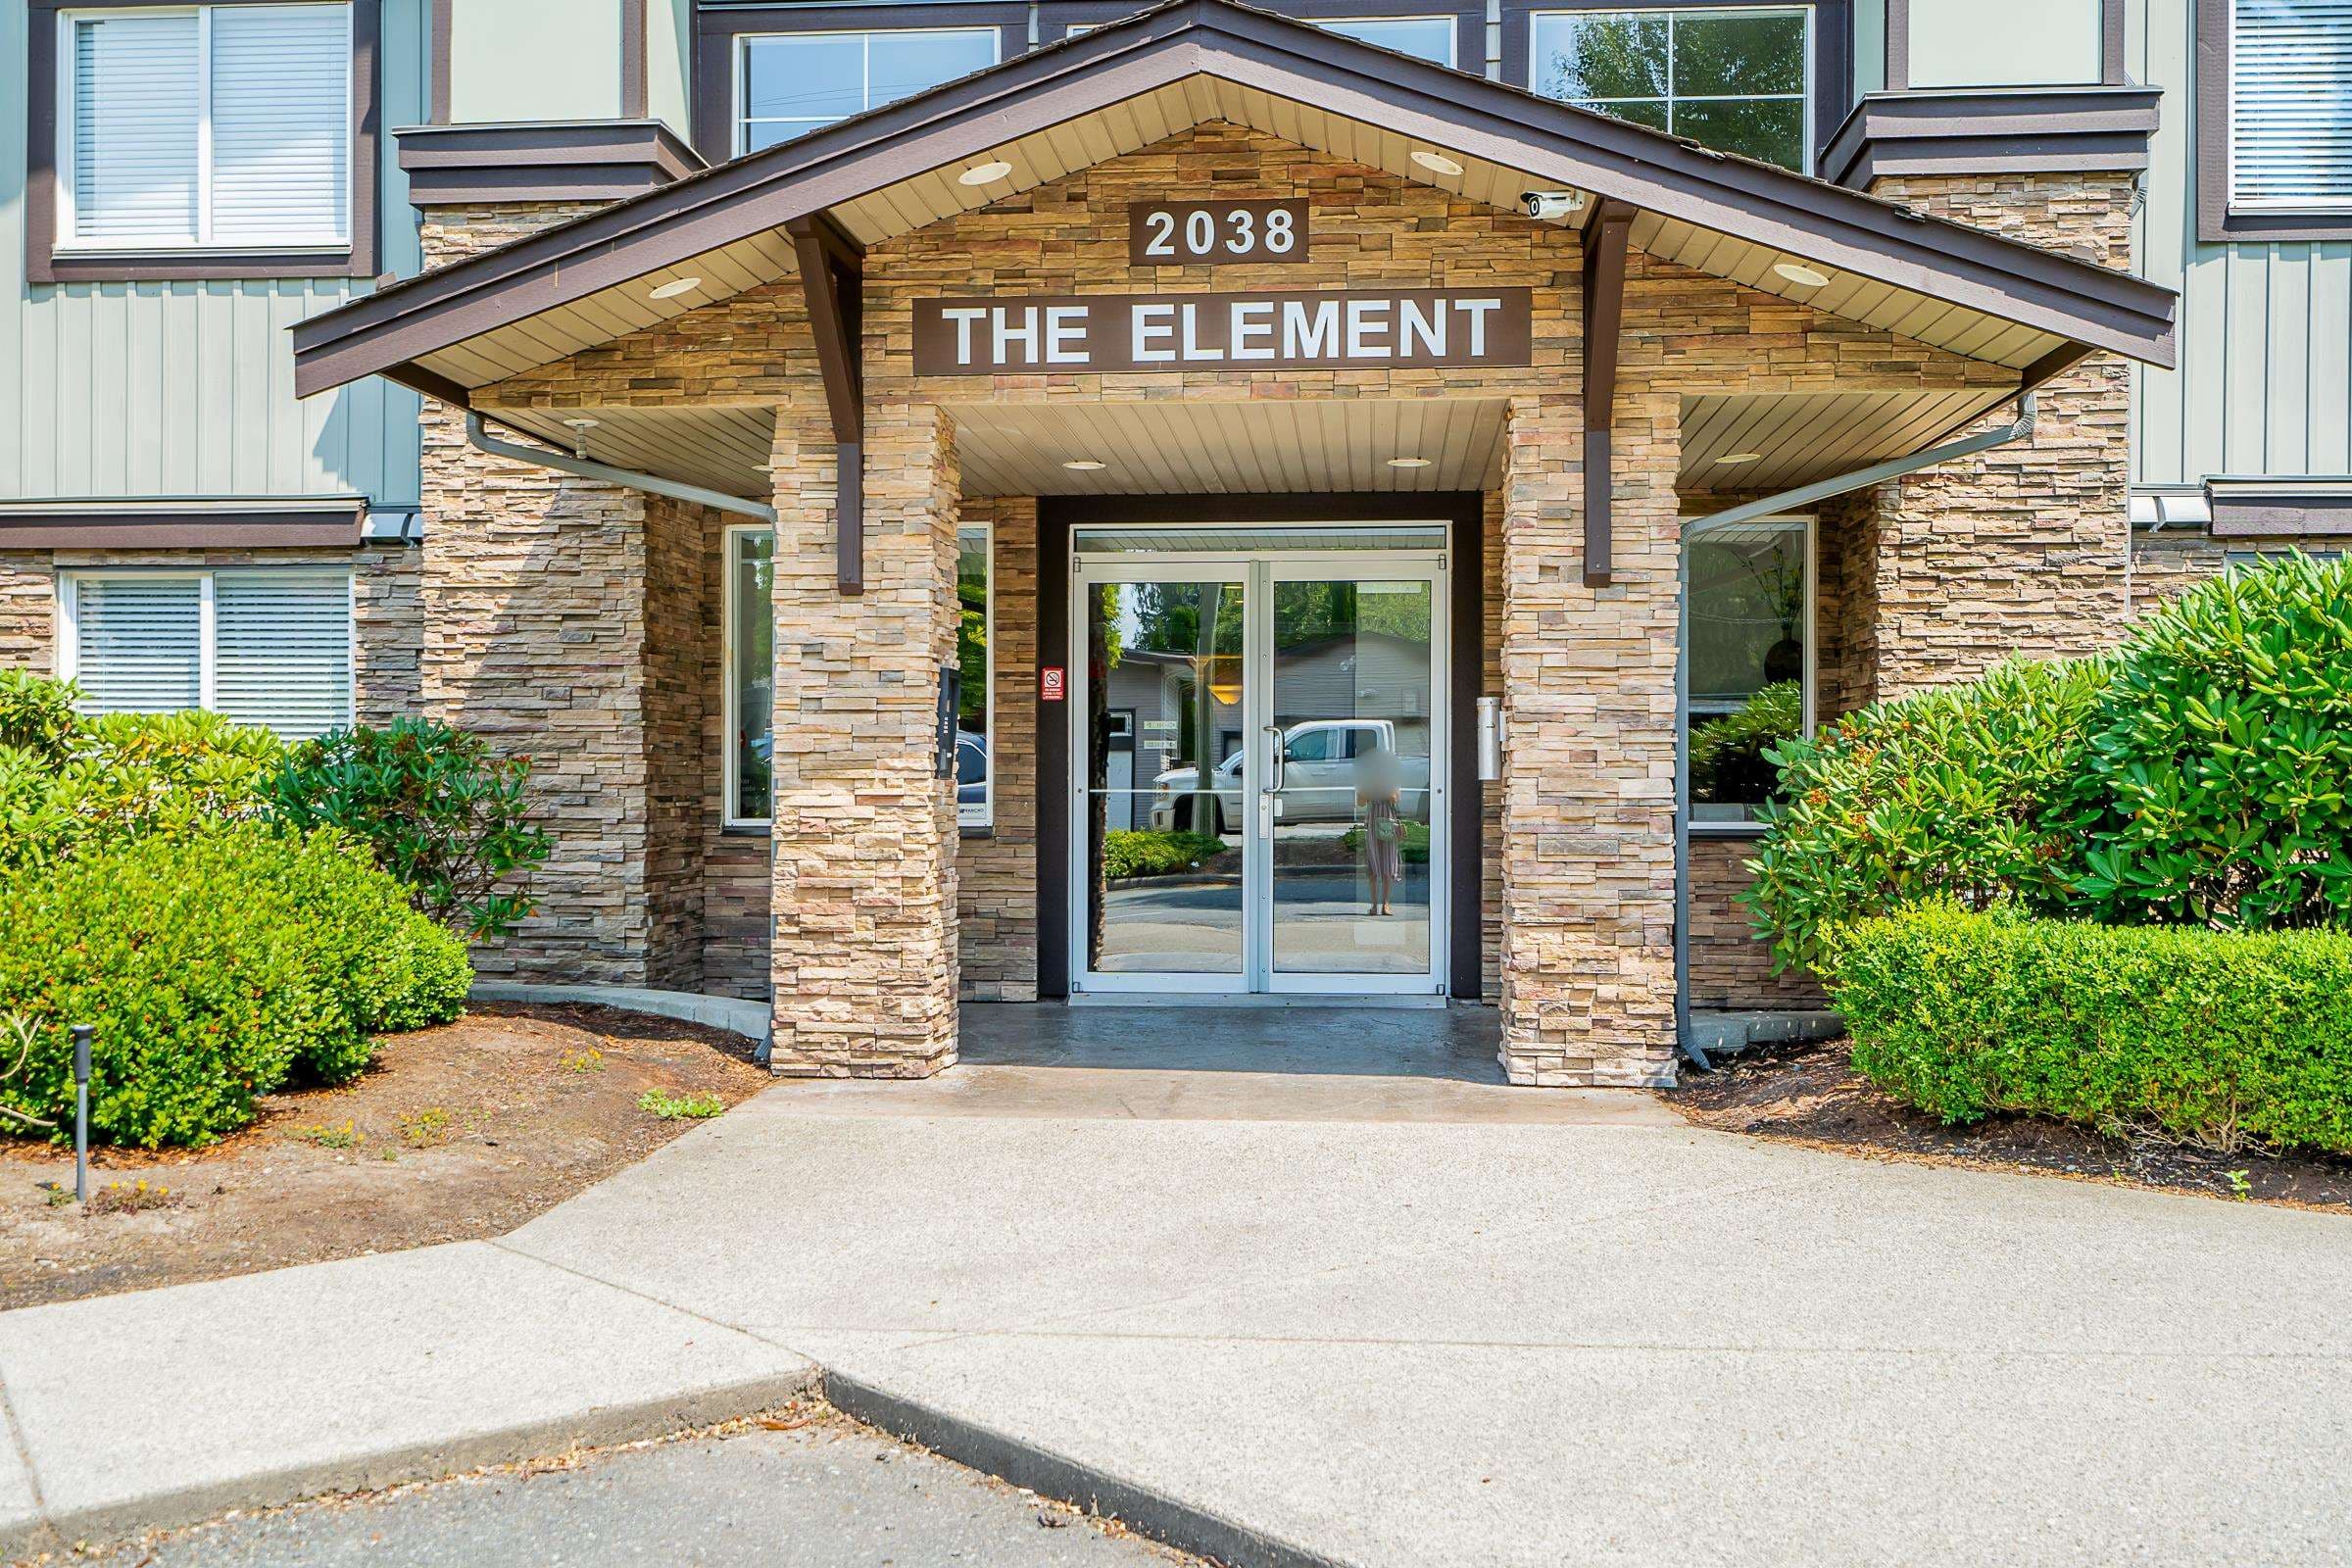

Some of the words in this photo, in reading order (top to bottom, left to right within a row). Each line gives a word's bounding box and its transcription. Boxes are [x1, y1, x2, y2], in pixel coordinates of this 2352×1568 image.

[1145, 209, 1295, 256] 2038
[942, 306, 1091, 365] THE
[1131, 298, 1501, 363] ELEMENT
